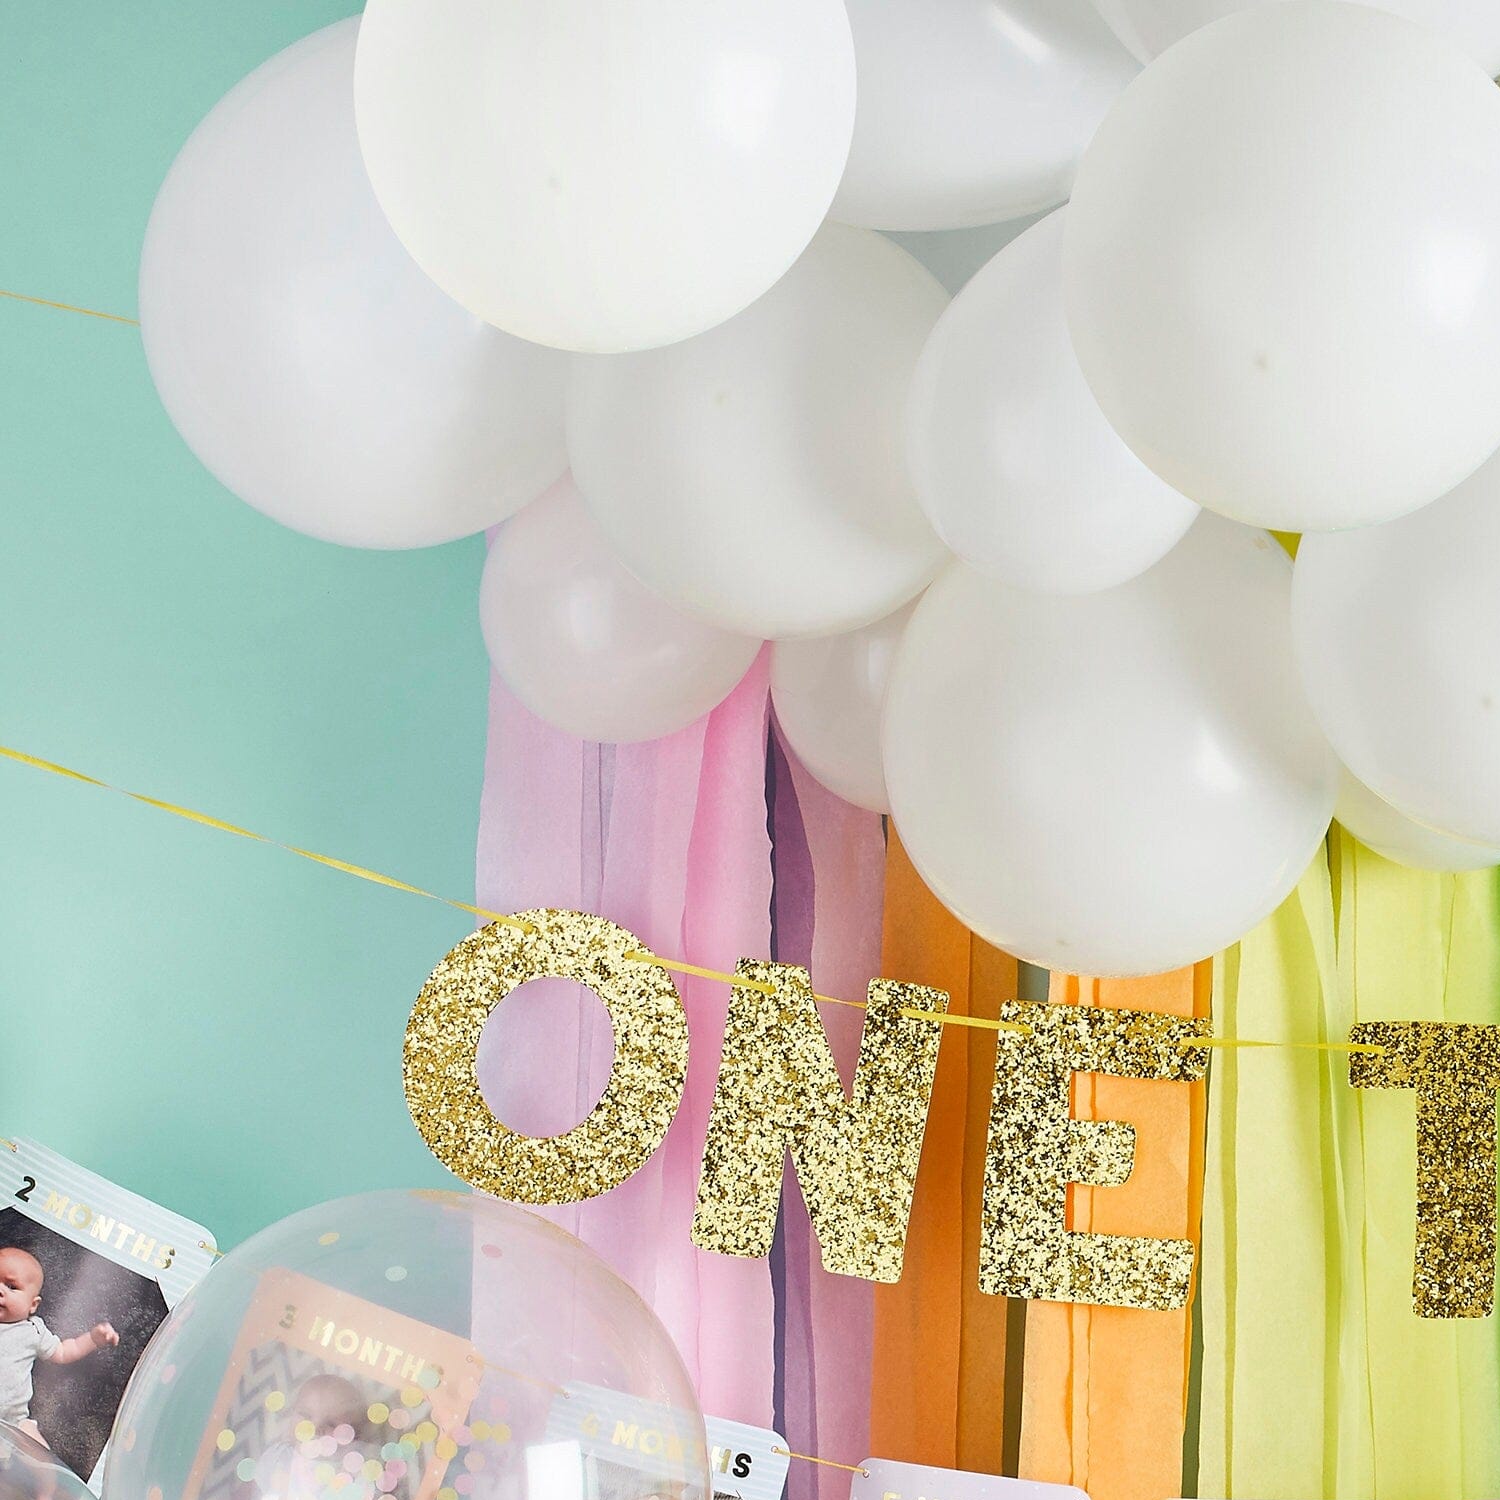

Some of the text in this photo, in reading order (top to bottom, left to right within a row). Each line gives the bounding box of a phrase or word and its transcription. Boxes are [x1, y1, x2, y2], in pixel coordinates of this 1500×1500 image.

[15, 1175, 176, 1270] 2 MONTHS
[403, 908, 1214, 1311] ONE
